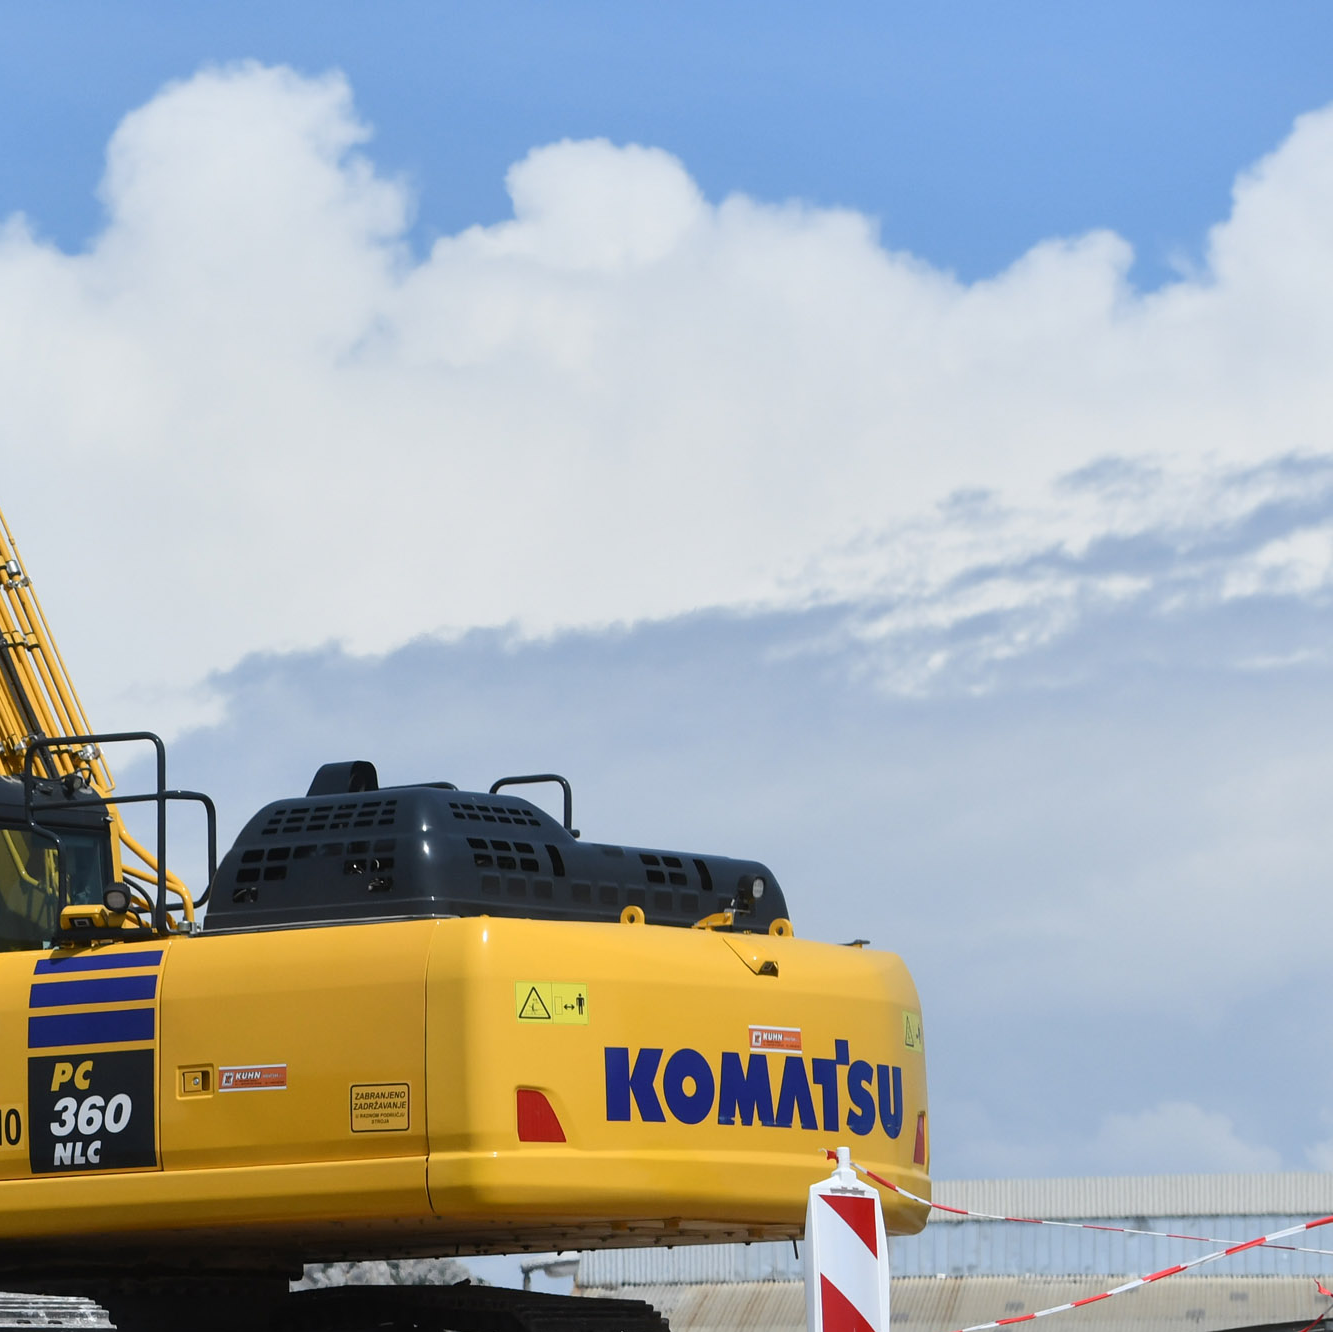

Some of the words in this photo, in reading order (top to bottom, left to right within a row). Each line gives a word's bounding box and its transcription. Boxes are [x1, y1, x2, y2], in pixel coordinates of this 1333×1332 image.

[763, 1032, 783, 1041] KUHN
[51, 1060, 93, 1091] PC
[235, 1071, 262, 1080] KUHN
[355, 1091, 406, 1101] ZABRANJENO
[604, 1039, 903, 1139] KOMATSU
[50, 1093, 132, 1136] 360
[353, 1101, 407, 1110] ZADRŽAVANJE
[53, 1140, 102, 1166] NLC
